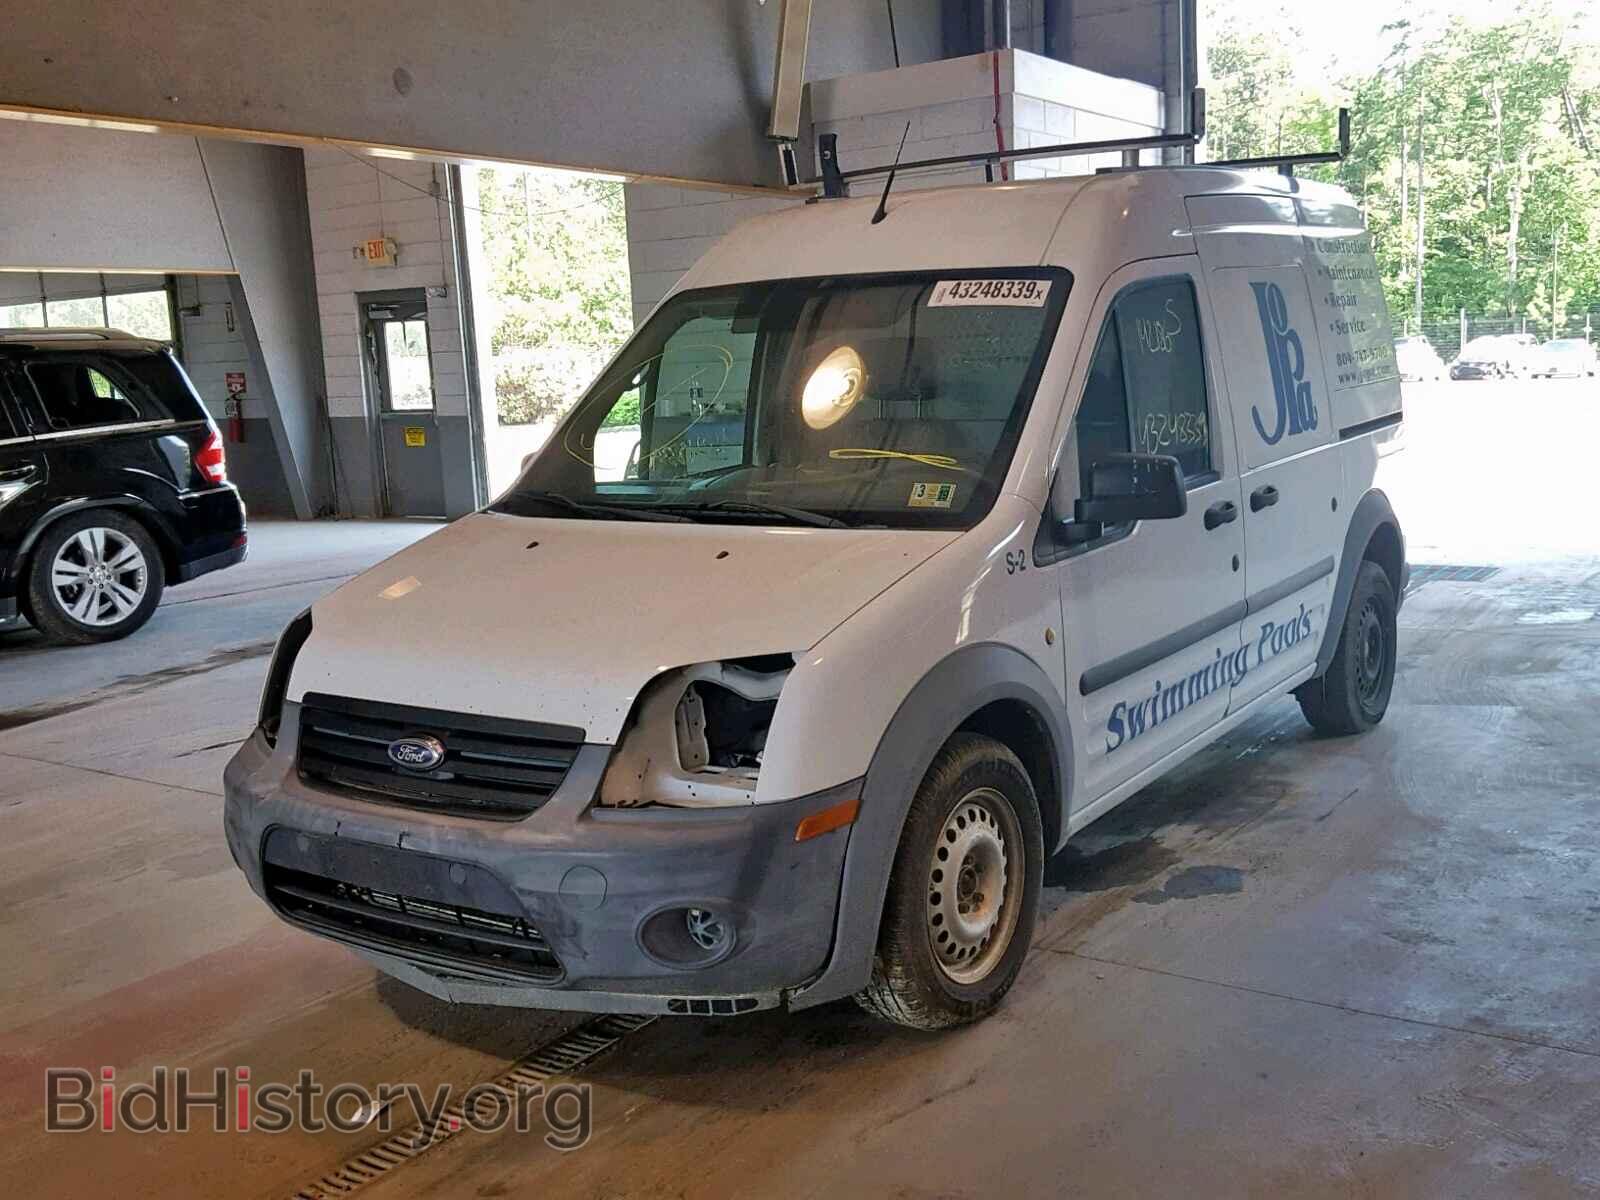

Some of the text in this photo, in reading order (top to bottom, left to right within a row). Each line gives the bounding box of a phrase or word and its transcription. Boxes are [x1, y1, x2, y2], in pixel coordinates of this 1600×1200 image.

[368, 240, 384, 259] EXIT
[1323, 264, 1375, 281] Maintenance
[1329, 288, 1358, 311] Repair
[1335, 317, 1367, 335] Service
[916, 484, 926, 498] 3
[1006, 549, 1026, 575] S-2
[1105, 603, 1312, 753] Swimming Pools
[397, 744, 426, 763] Ford
